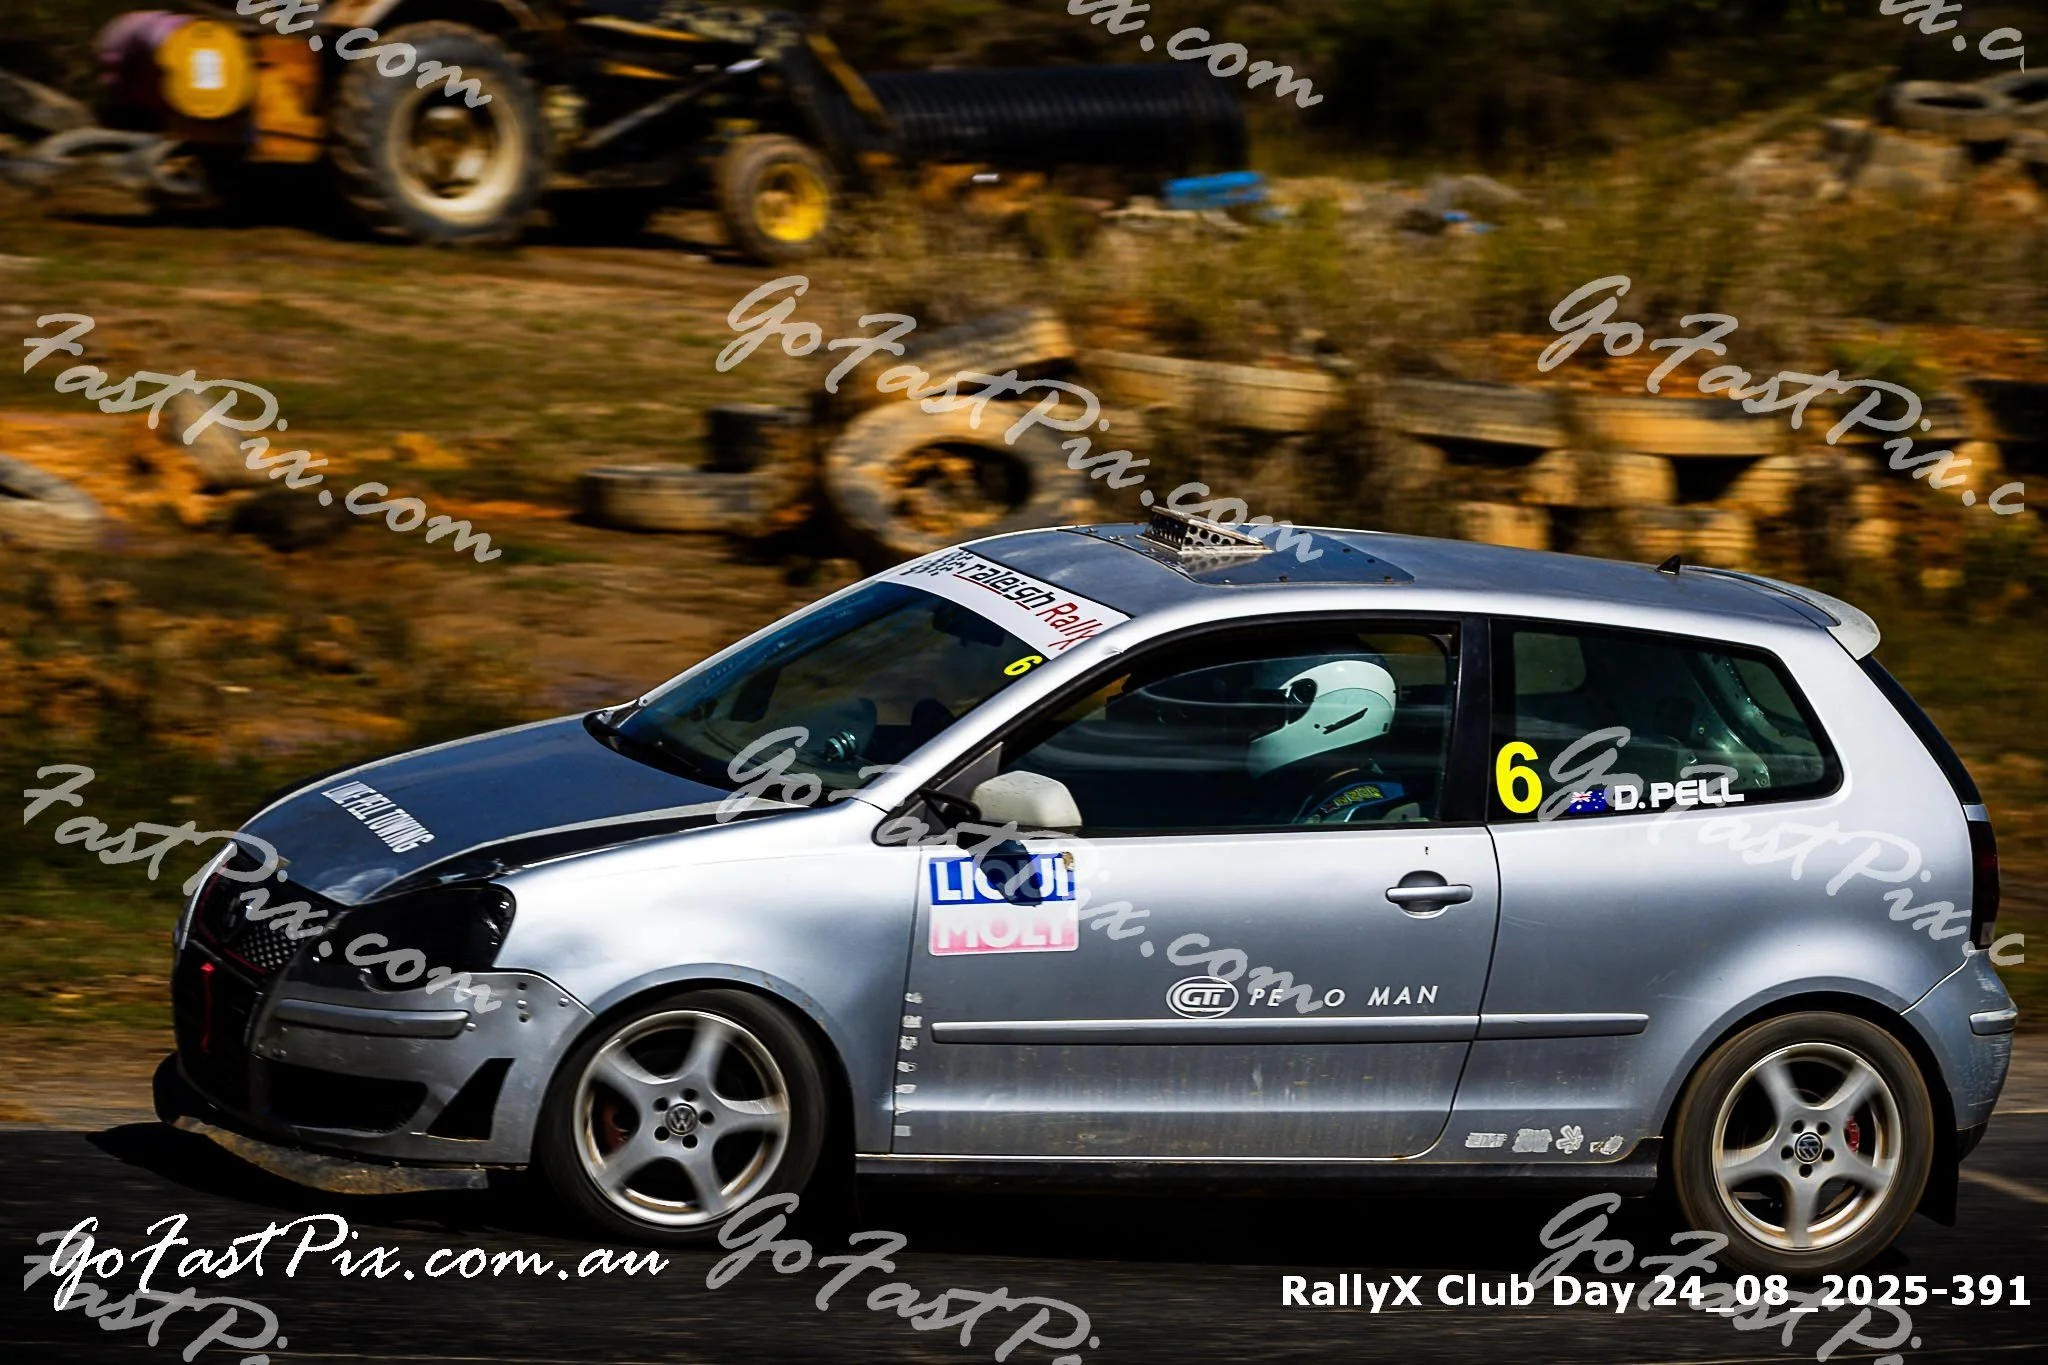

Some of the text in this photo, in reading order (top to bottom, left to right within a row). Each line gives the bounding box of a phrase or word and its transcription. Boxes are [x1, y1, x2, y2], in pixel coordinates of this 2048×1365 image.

[1003, 655, 1043, 676] 6
[1495, 741, 1543, 814] 6
[364, 808, 435, 853] TOWING
[937, 907, 1072, 948] MOLY
[1367, 985, 1439, 1006] MAN
